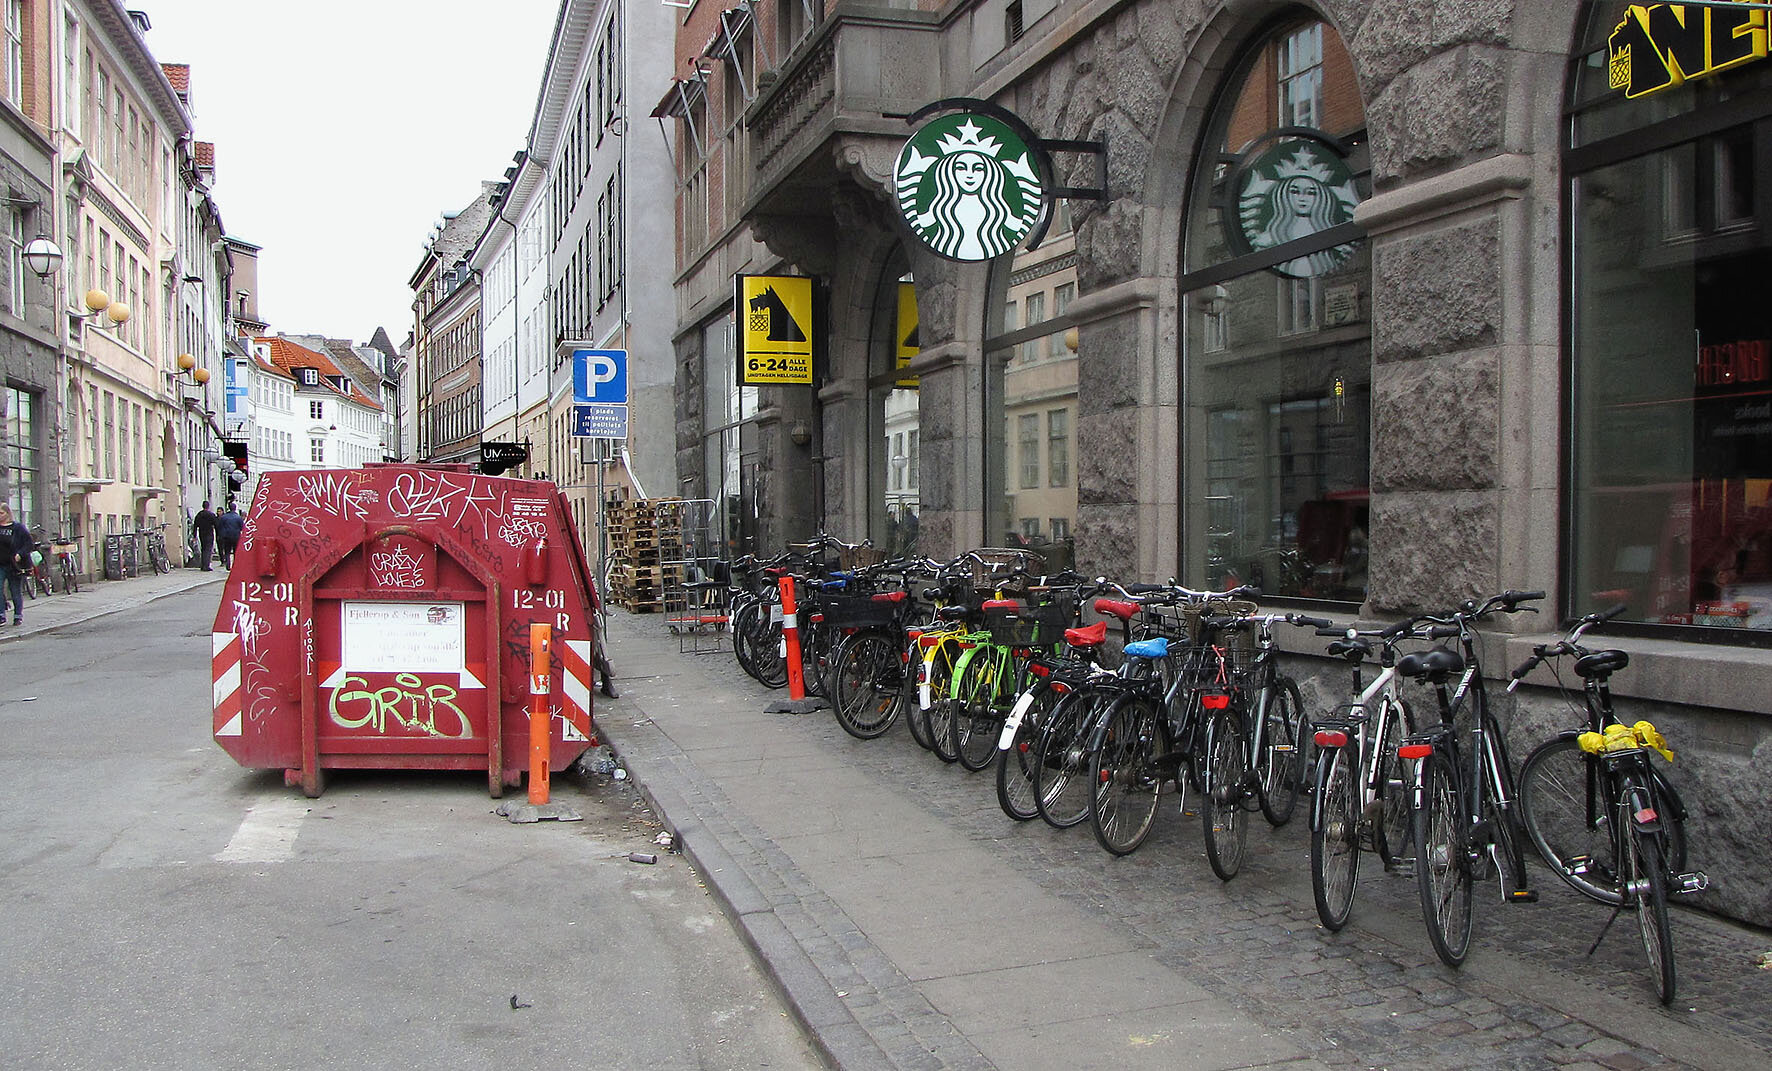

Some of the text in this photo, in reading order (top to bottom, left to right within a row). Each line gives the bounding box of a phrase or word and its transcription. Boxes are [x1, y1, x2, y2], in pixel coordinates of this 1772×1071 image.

[748, 358, 788, 372] 6-24
[586, 355, 617, 398] P
[240, 581, 294, 603] 12-01
[513, 589, 565, 609] 12-01
[285, 606, 299, 626] R
[349, 609, 390, 620] Fjellerup
[391, 610, 399, 619] &
[556, 612, 570, 632] R
